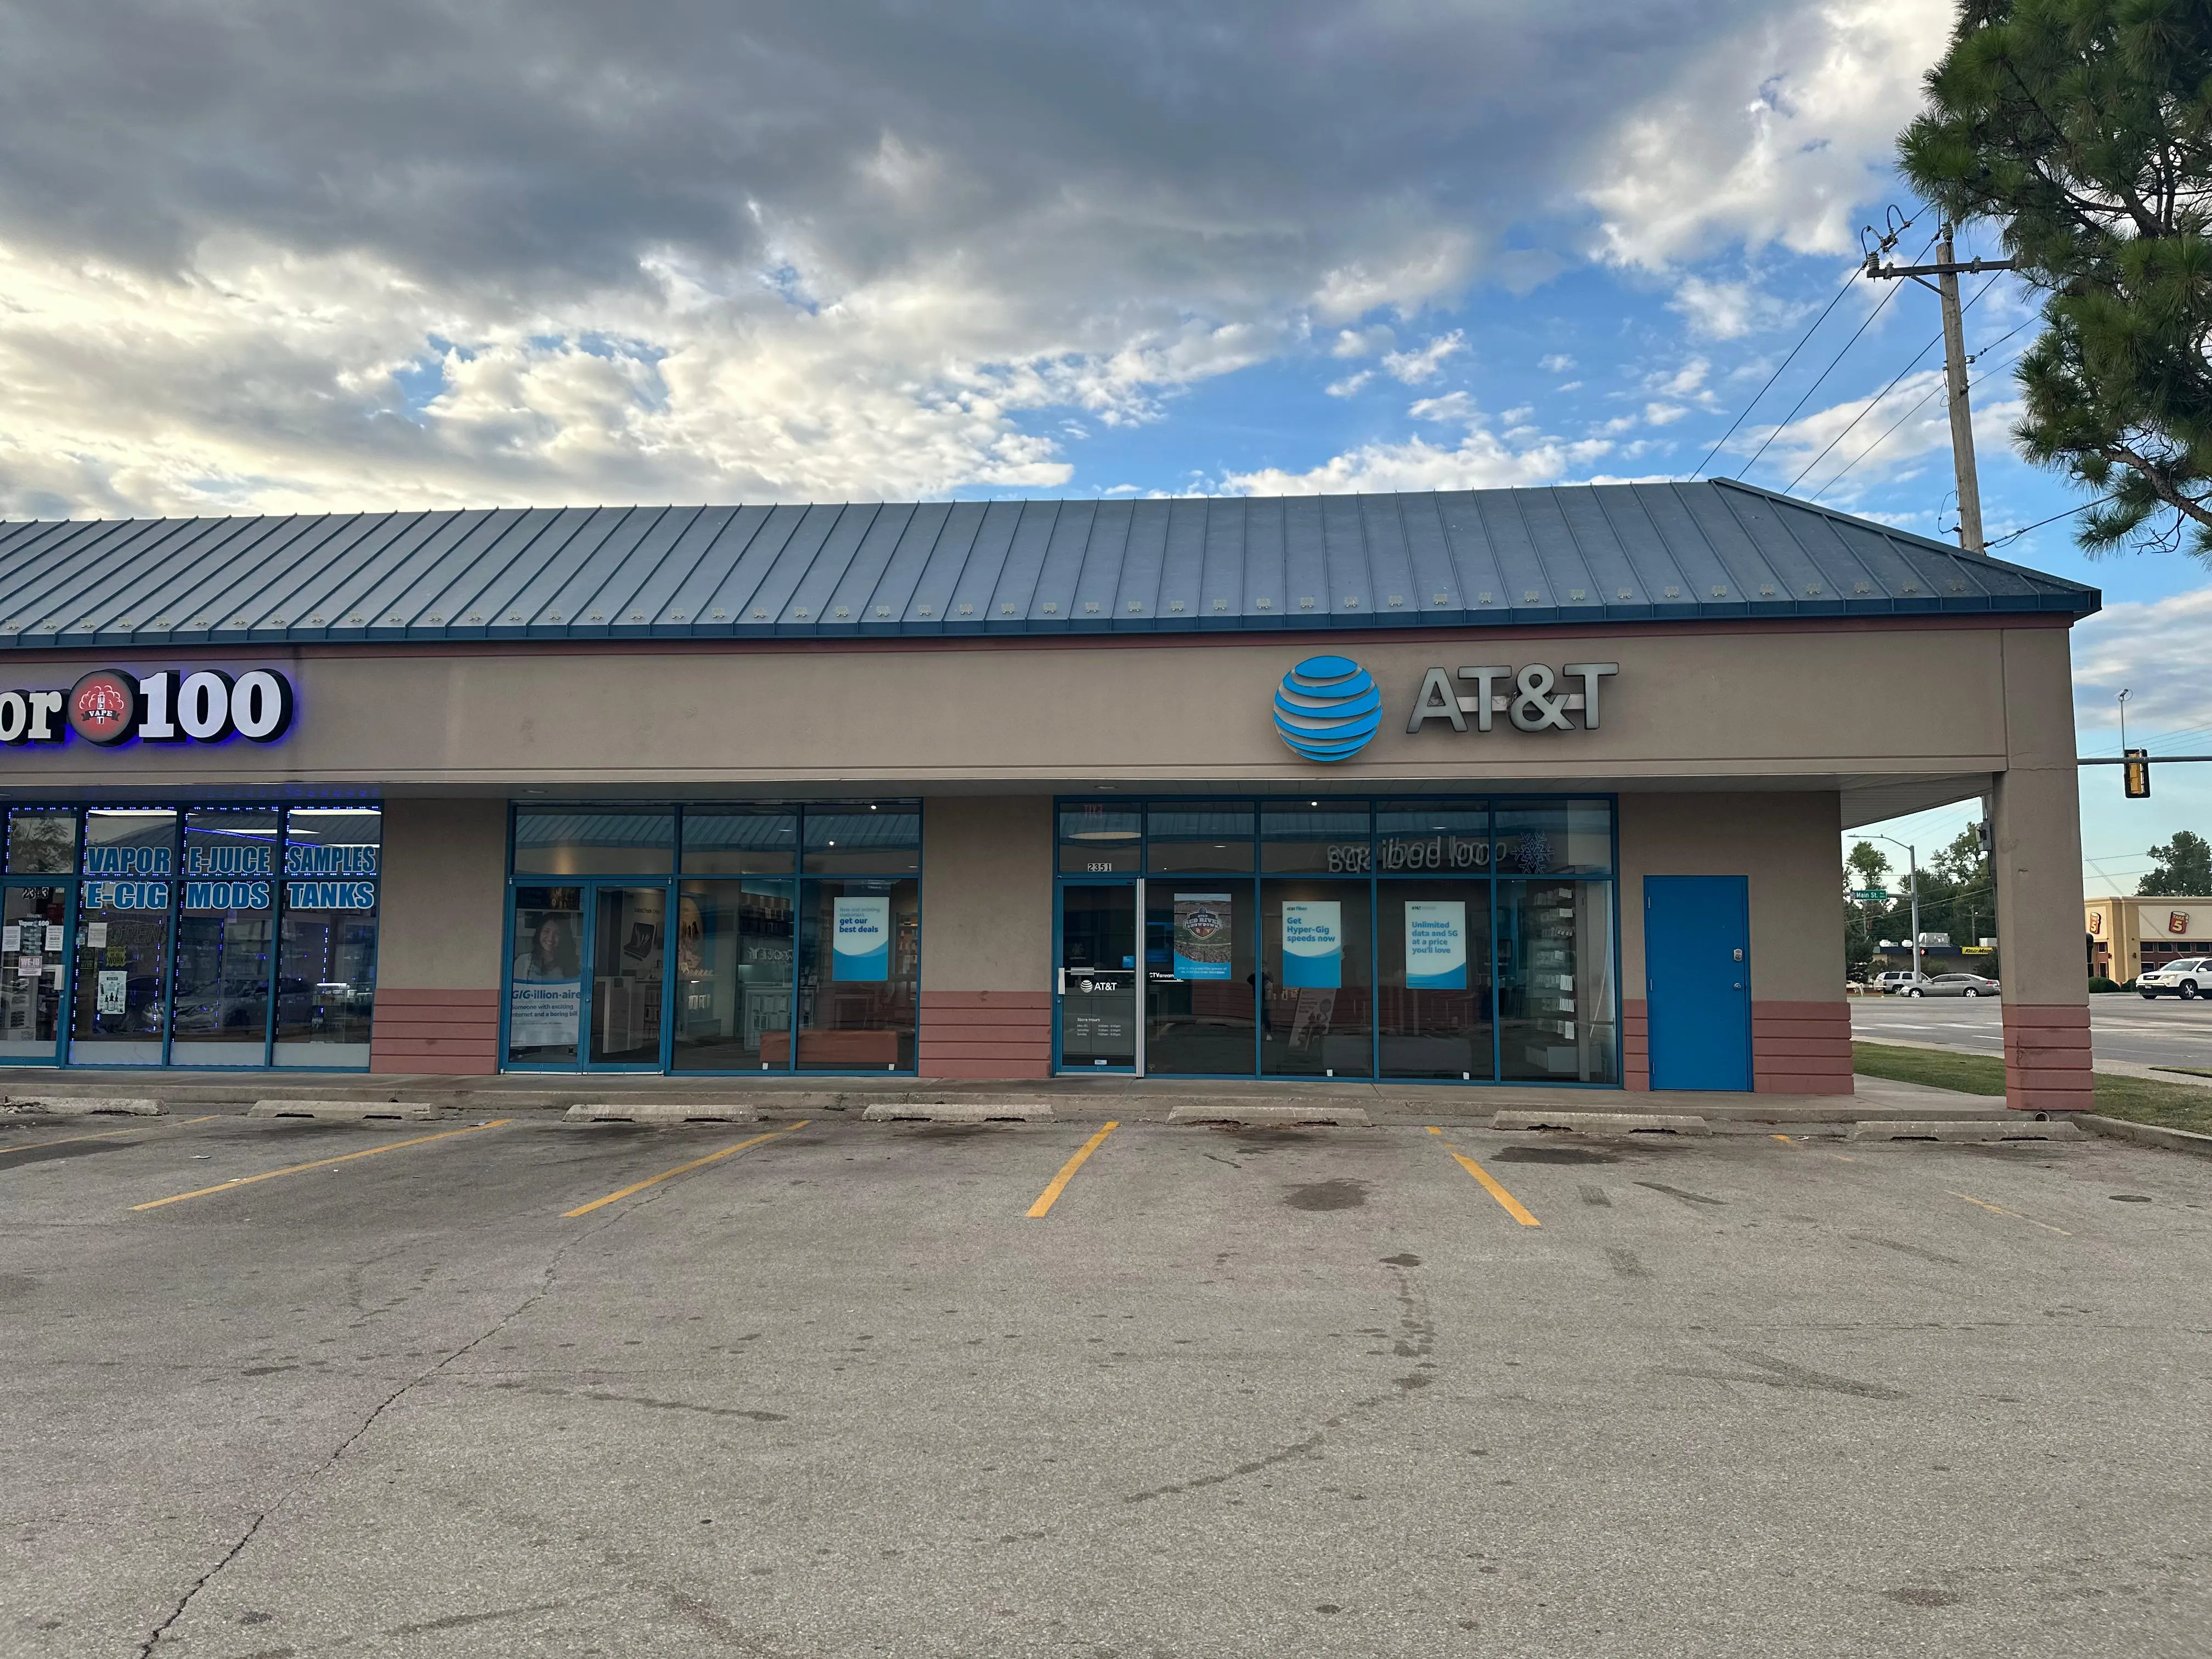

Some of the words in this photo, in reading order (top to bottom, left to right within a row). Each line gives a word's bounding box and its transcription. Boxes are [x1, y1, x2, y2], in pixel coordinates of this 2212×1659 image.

[138, 670, 283, 738] 100
[1406, 662, 1620, 734] AT&T
[87, 847, 172, 873] VAPOR
[188, 847, 271, 873] E-JUICE
[288, 846, 376, 873] SAMPLES
[85, 882, 168, 910] E-CIG
[185, 882, 269, 909] MODS
[287, 882, 375, 909] TANKS
[1287, 926, 1330, 935] Hyper-Gig
[1287, 935, 1316, 943] speeds
[2091, 922, 2097, 932] 5
[2172, 921, 2182, 932] 5
[1412, 946, 1433, 955] you'll
[1429, 938, 1448, 946] price
[1094, 982, 1118, 991] AT&T
